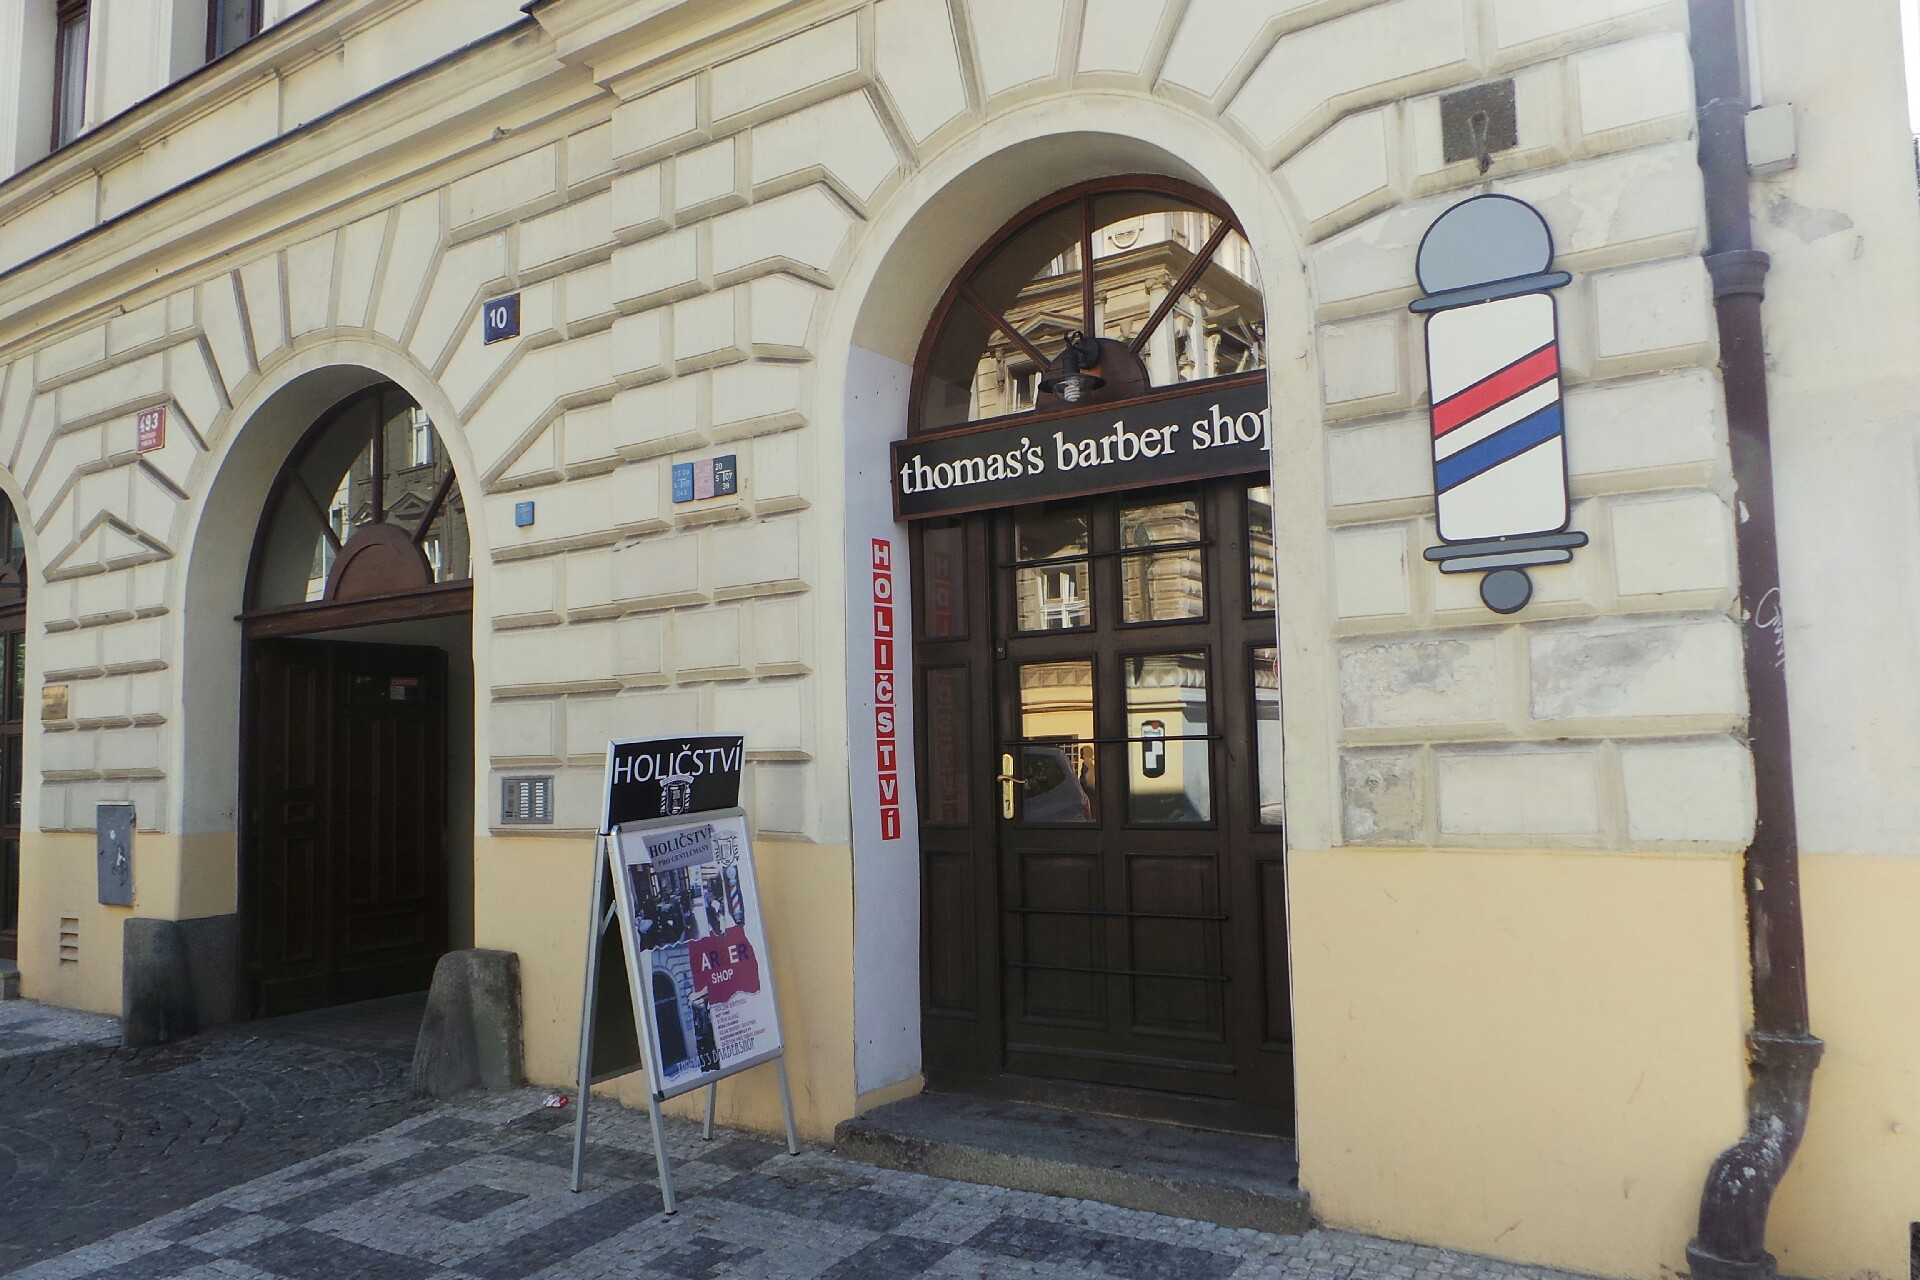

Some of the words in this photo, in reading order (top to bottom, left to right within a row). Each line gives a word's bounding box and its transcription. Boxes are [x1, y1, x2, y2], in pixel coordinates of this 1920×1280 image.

[489, 306, 507, 329] 10
[139, 412, 159, 433] 493
[899, 437, 1045, 495] thomas's
[1052, 420, 1180, 471] barber
[873, 543, 897, 838] HOLIČSTVÍ
[613, 740, 742, 784] HOLIČSTVÍ
[648, 823, 713, 859] HOLIČSTVÍ
[711, 968, 734, 984] SHOP
